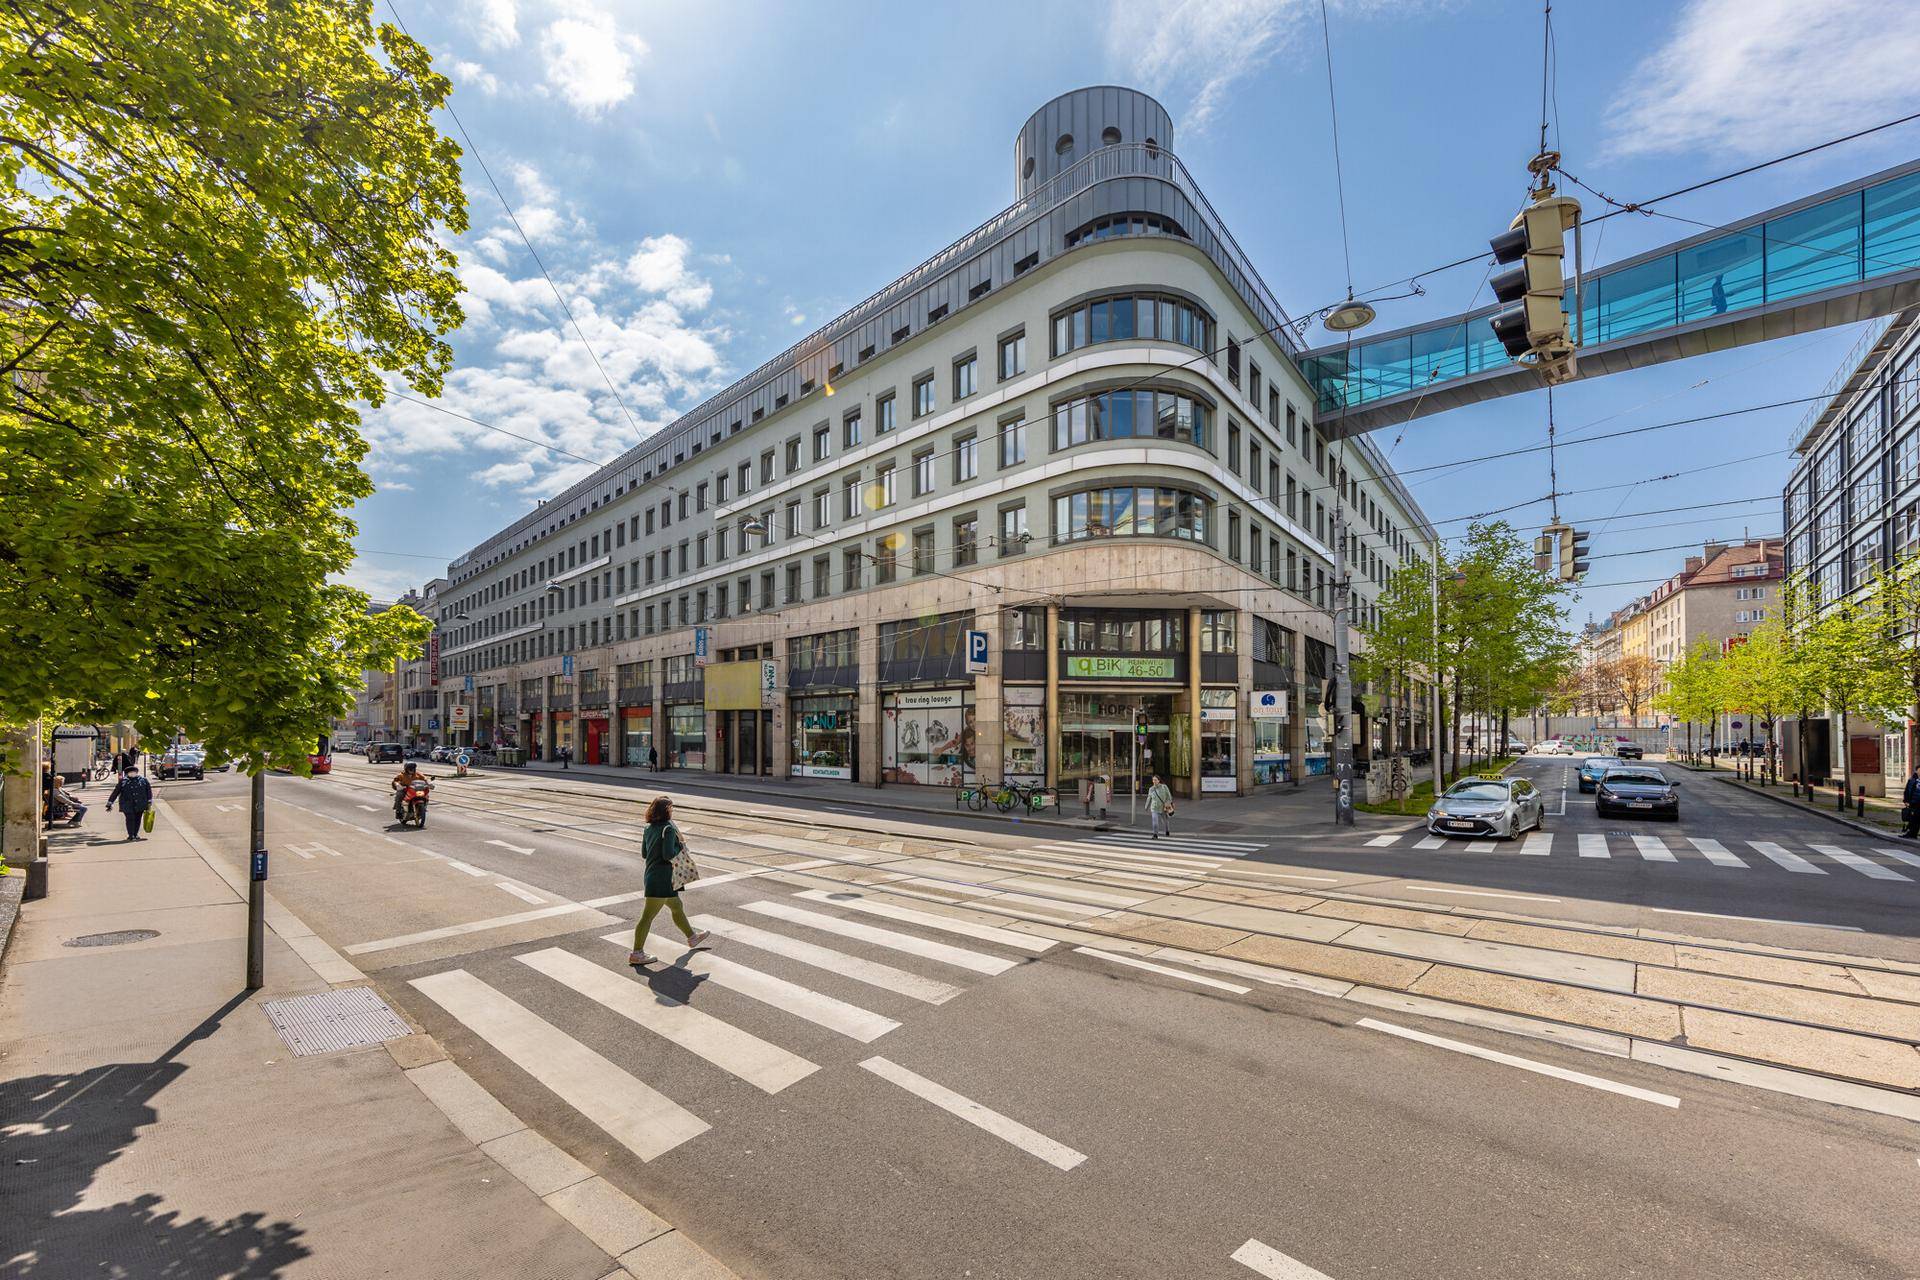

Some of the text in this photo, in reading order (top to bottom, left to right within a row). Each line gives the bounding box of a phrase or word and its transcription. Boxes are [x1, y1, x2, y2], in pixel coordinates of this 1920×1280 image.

[973, 635, 986, 659] P
[1128, 665, 1163, 677] 46-50
[918, 695, 929, 705] ring
[931, 695, 952, 704] lounge
